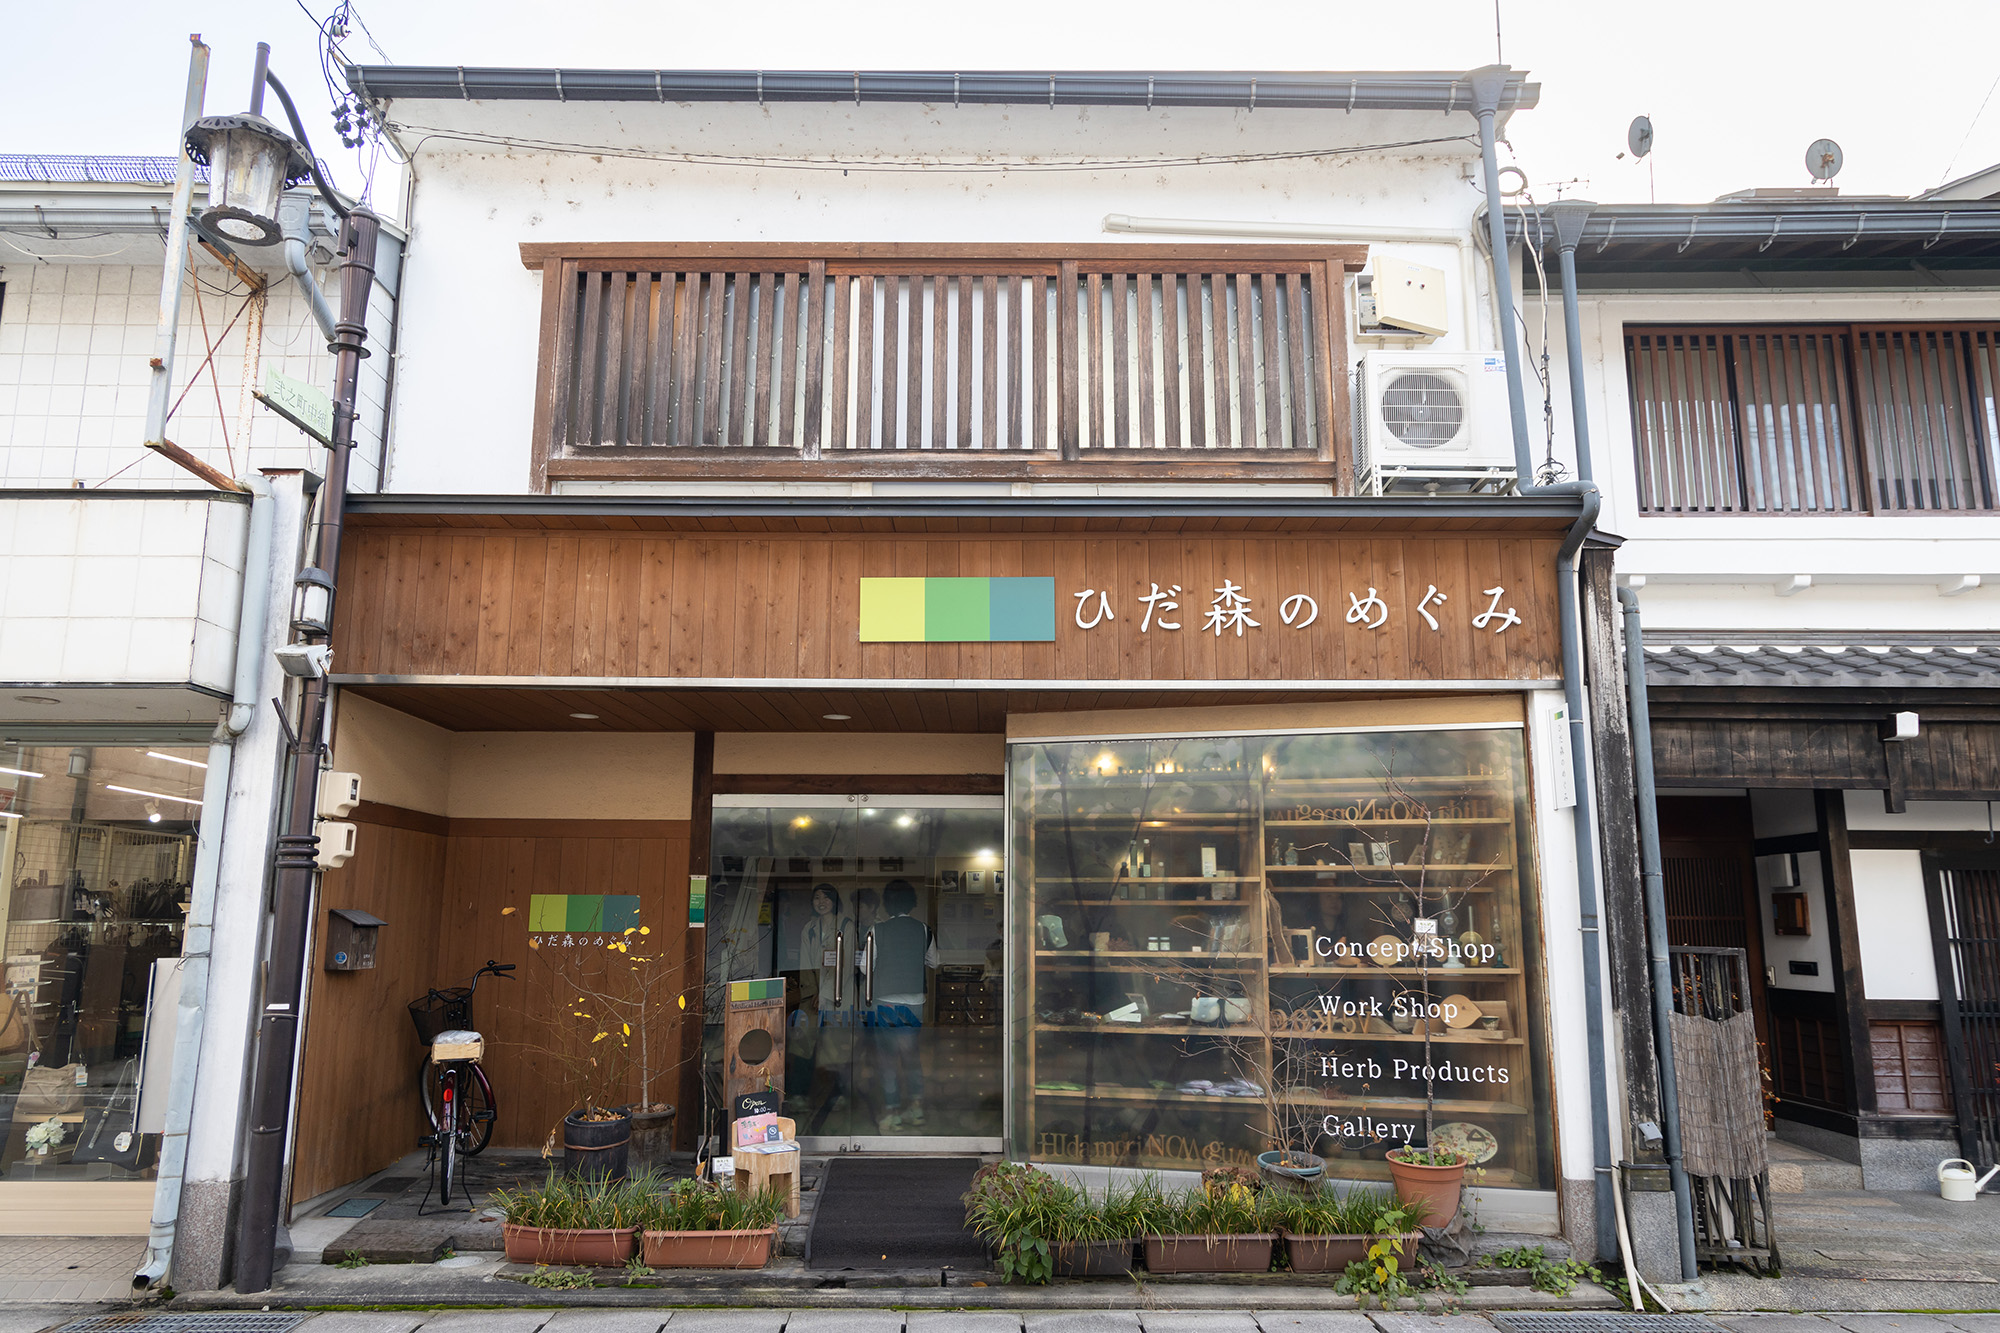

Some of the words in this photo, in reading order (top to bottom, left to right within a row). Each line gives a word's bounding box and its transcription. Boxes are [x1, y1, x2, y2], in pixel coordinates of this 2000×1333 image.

[1073, 578, 1522, 637] ひだ森のめぐみ
[1430, 937, 1495, 963] Shop
[1318, 995, 1384, 1017] Work
[1394, 996, 1458, 1023] Shop
[1321, 1056, 1382, 1079] Herb
[1393, 1058, 1510, 1084] Products
[741, 1097, 767, 1110] Open
[1322, 1114, 1416, 1144] Gallery
